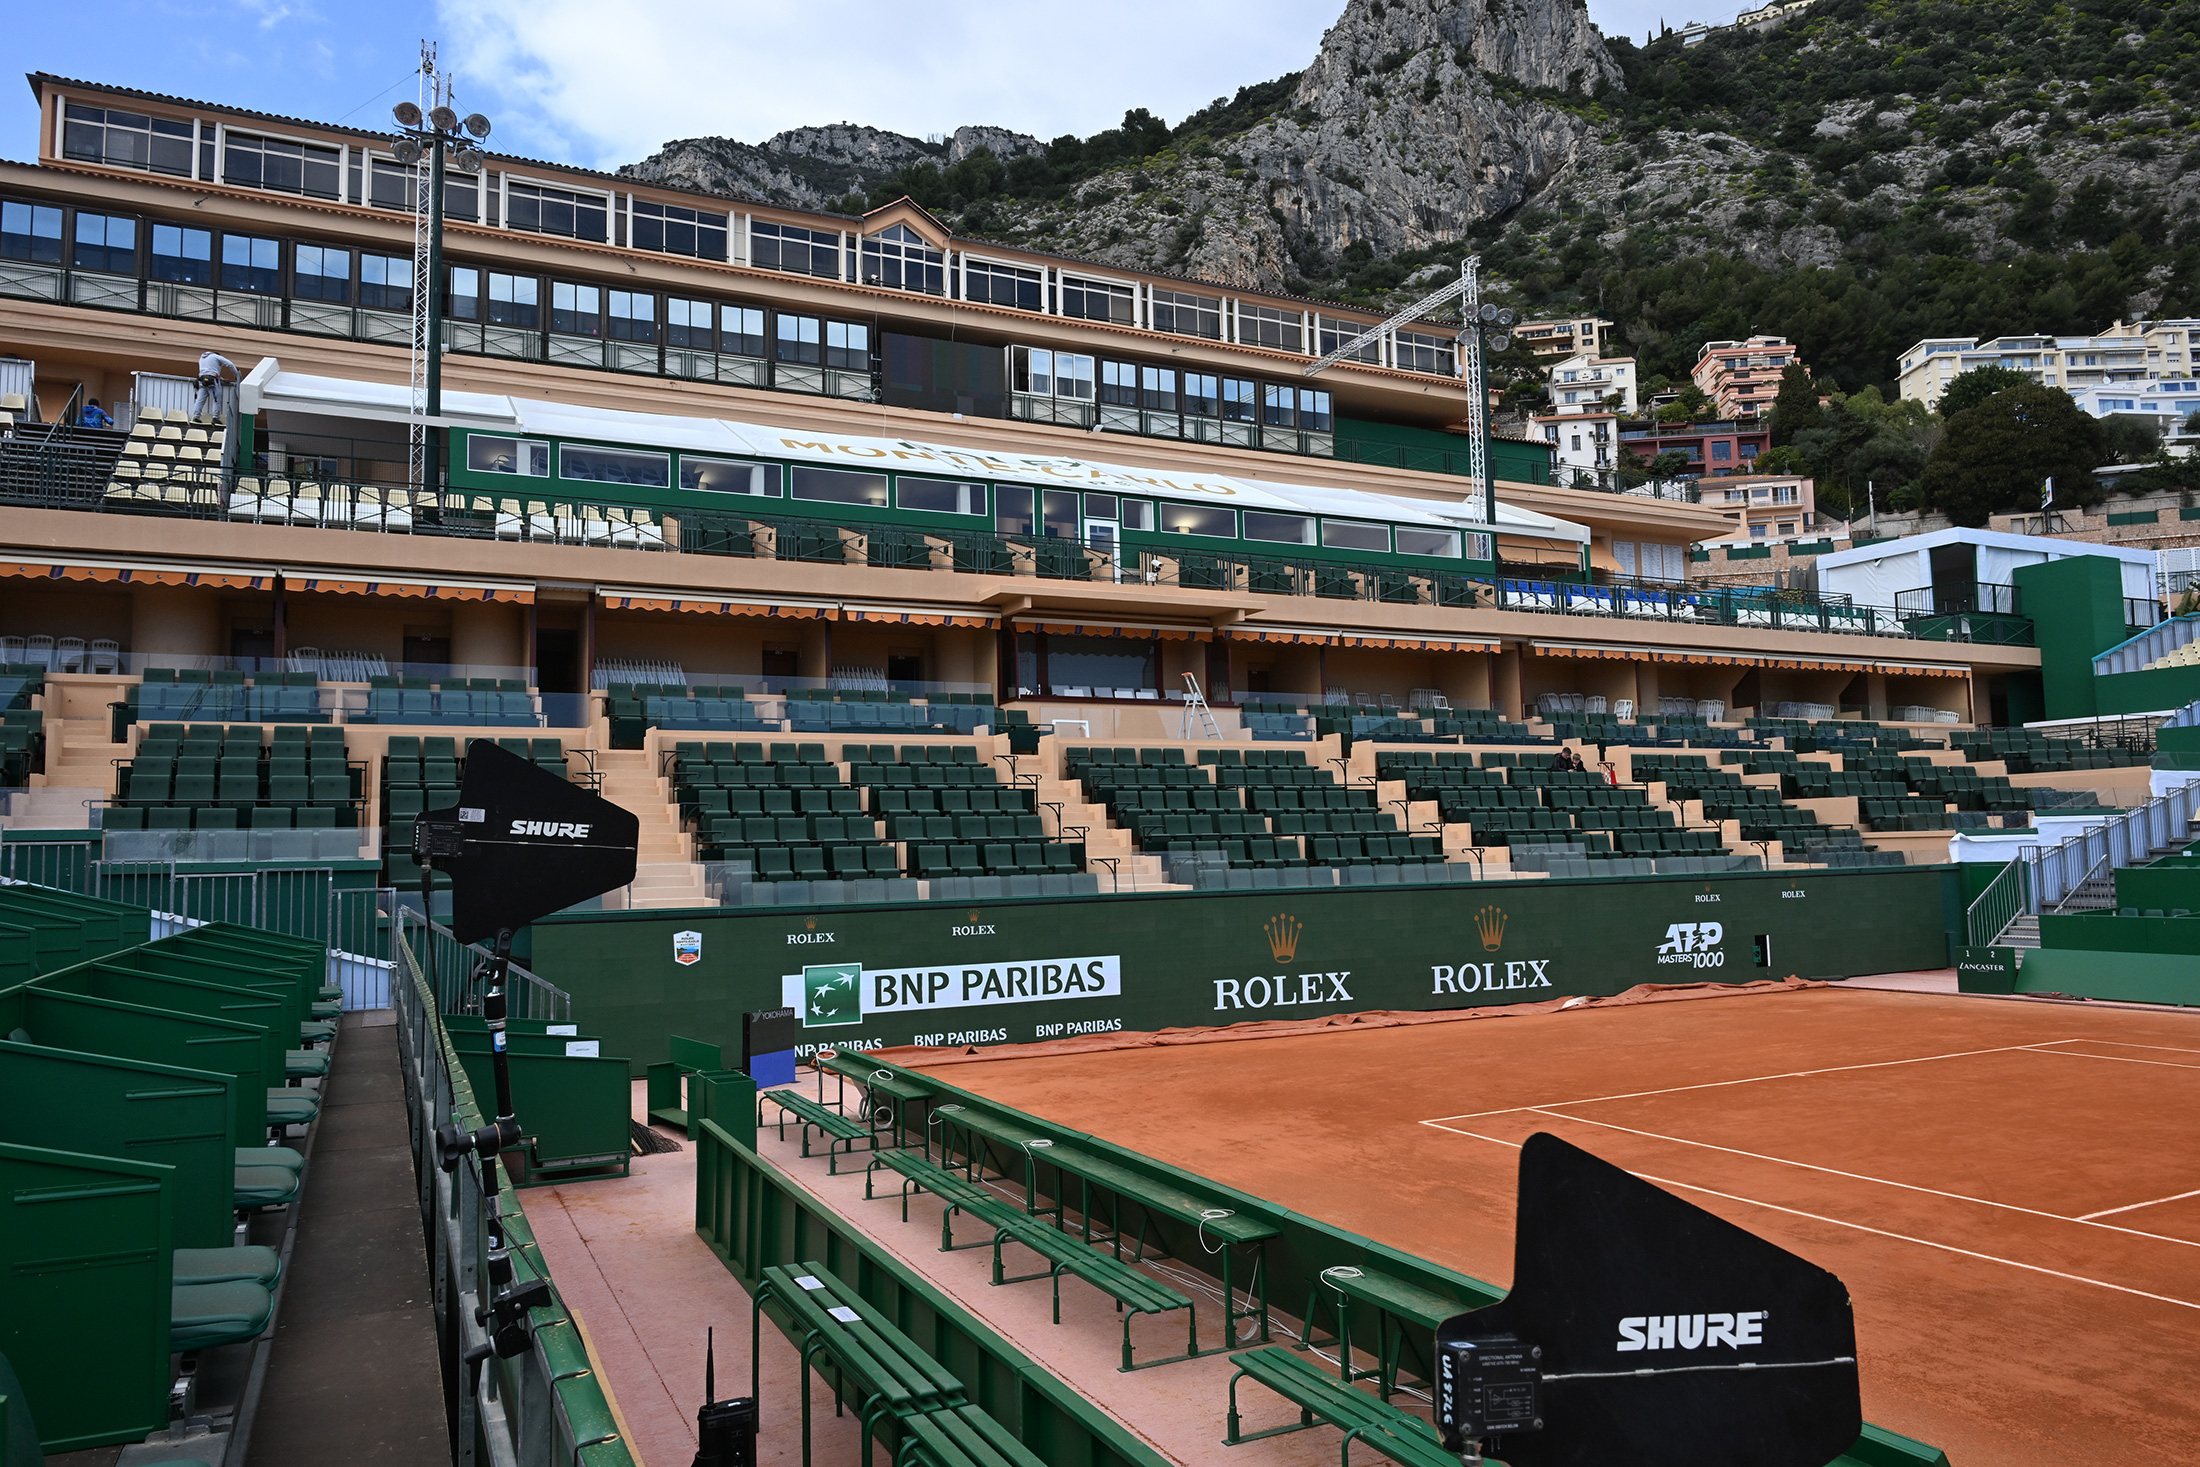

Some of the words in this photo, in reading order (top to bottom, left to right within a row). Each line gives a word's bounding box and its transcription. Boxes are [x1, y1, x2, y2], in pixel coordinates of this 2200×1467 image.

[509, 820, 590, 839] SHURE
[1694, 894, 1721, 903] ROLEX
[1781, 890, 1806, 899] ROLEX
[786, 932, 835, 945] ROLEX
[952, 924, 996, 936] ROLEX
[1655, 921, 1723, 954] ATP
[1657, 953, 1693, 964] MASTERS
[1693, 951, 1725, 969] 1000
[1965, 949, 1971, 958] 1
[1990, 950, 1996, 959] 2
[1959, 962, 2005, 972] LANCASTER
[874, 972, 950, 1008] BNP
[962, 960, 1106, 1001] PARIBAS
[1430, 959, 1553, 995] ROLEX
[1213, 971, 1354, 1011] ROLEX
[761, 1009, 793, 1020] YOKOHAMA
[913, 1033, 945, 1047] BNP
[947, 1027, 1008, 1045] PARIBAS
[1035, 1023, 1064, 1038] BNP
[1066, 1018, 1122, 1034] PARIBAS
[794, 1043, 815, 1058] NP
[818, 1038, 883, 1052] PIBAS
[1616, 1311, 1763, 1351] SHURE
